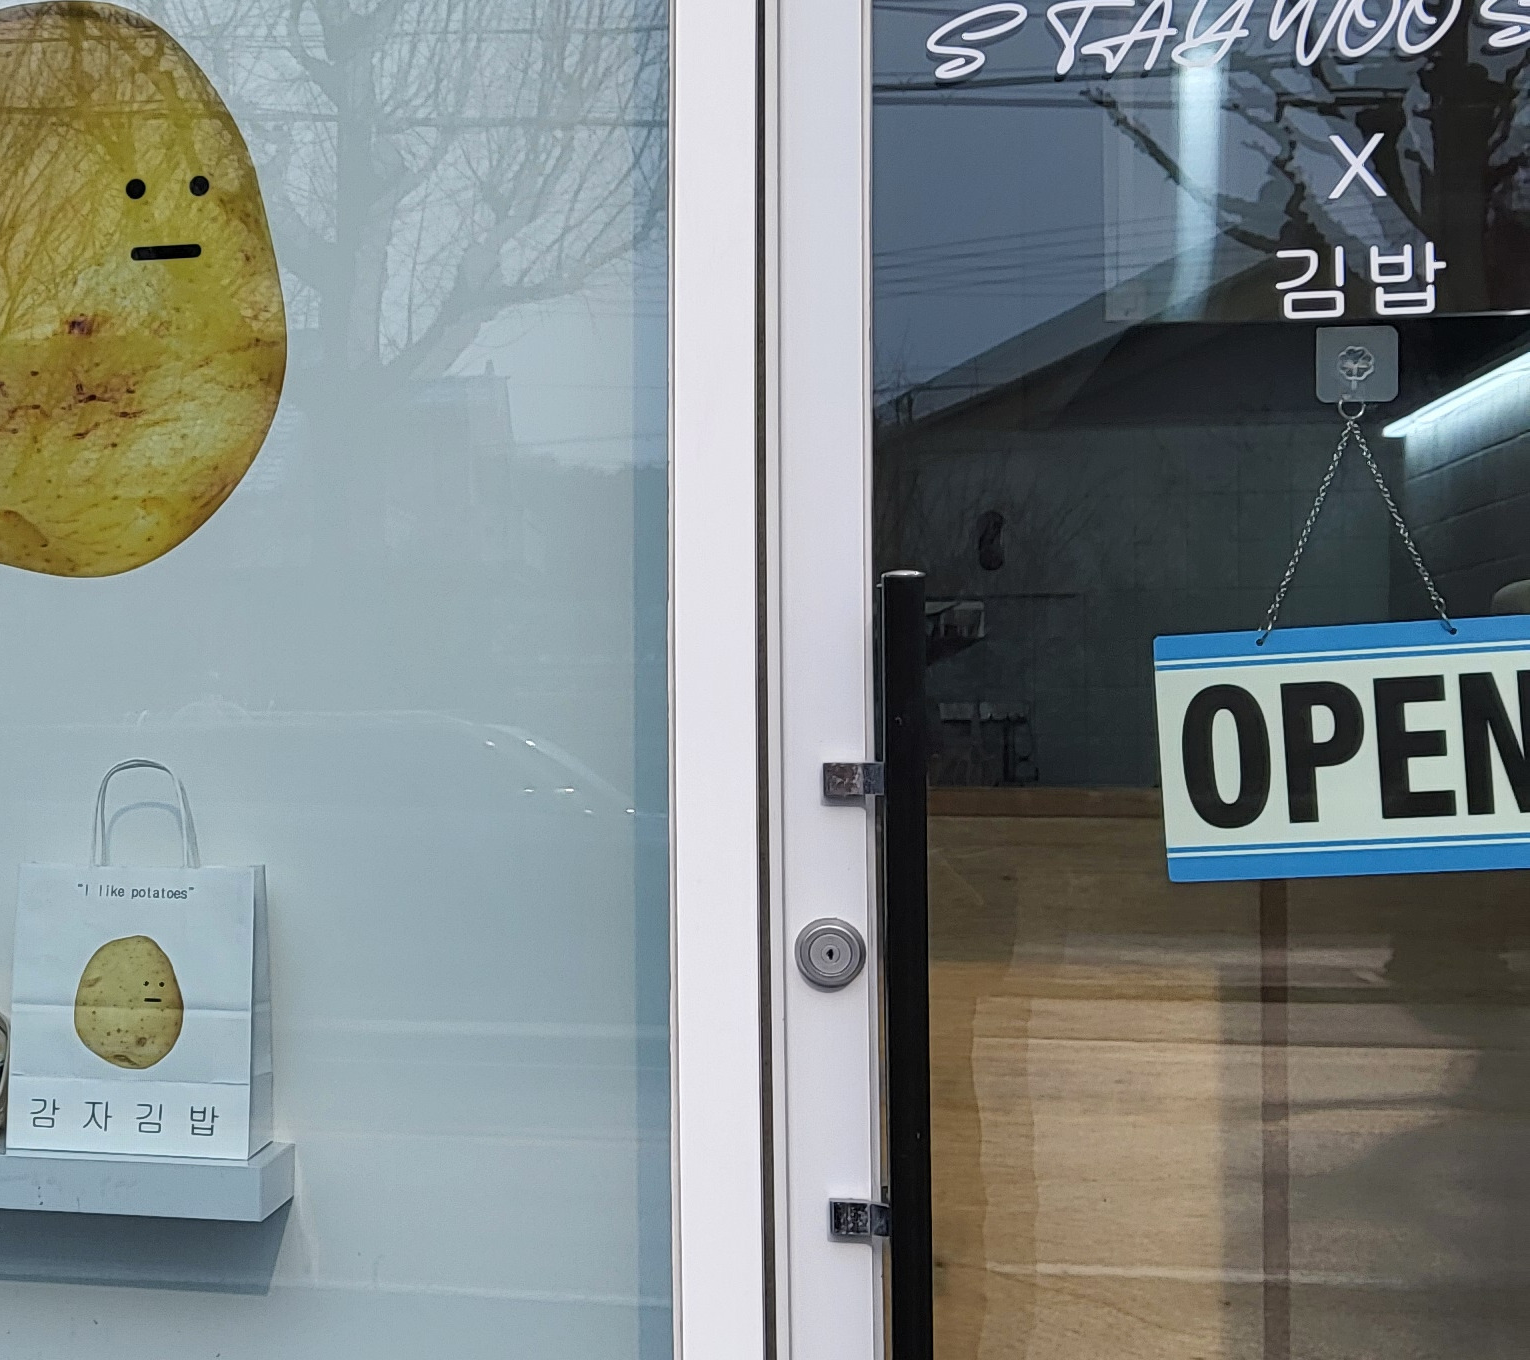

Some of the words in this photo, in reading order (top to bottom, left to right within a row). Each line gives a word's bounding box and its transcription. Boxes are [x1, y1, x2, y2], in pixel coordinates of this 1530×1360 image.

[1274, 240, 1448, 321] 김밥
[1180, 669, 1530, 830] OPEN
[98, 884, 125, 897] like
